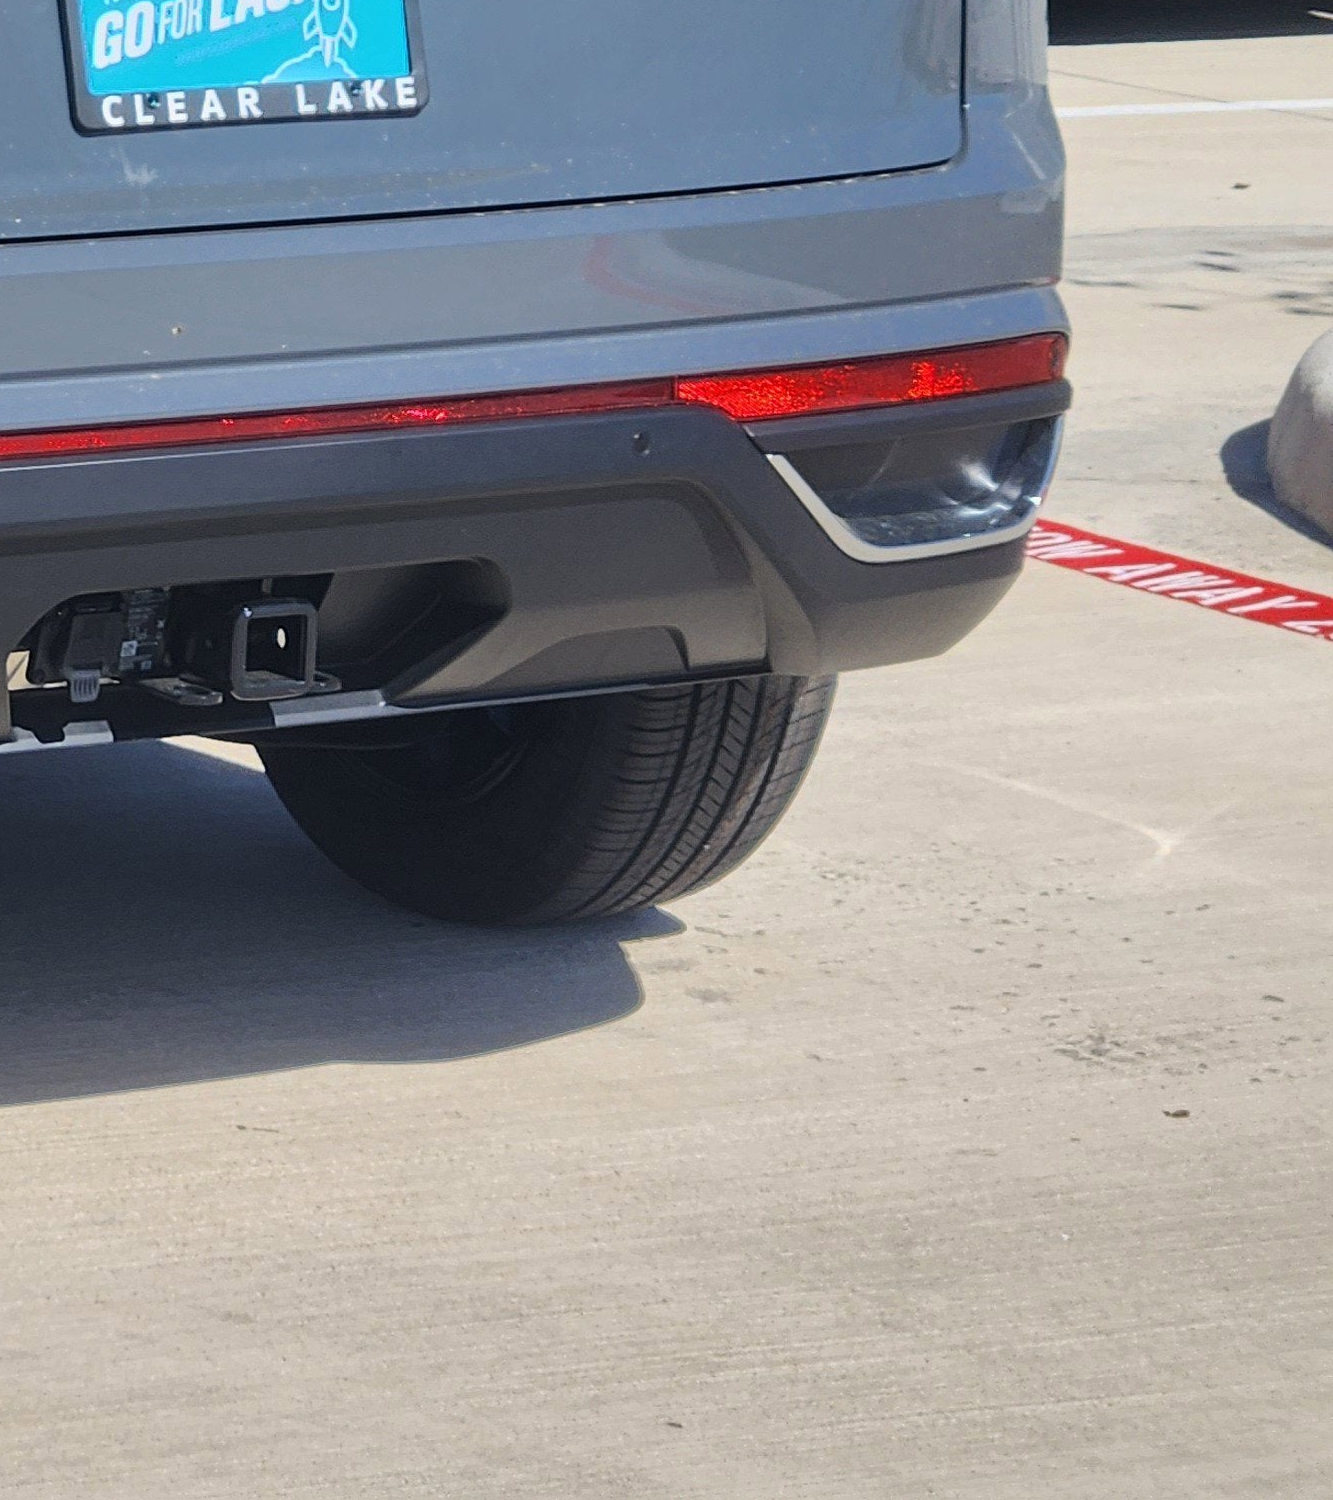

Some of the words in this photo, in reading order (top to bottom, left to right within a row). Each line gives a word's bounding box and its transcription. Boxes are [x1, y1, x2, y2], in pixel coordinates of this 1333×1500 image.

[91, 0, 156, 70] GO
[101, 86, 264, 128] CLEAR
[295, 75, 419, 115] LAKE
